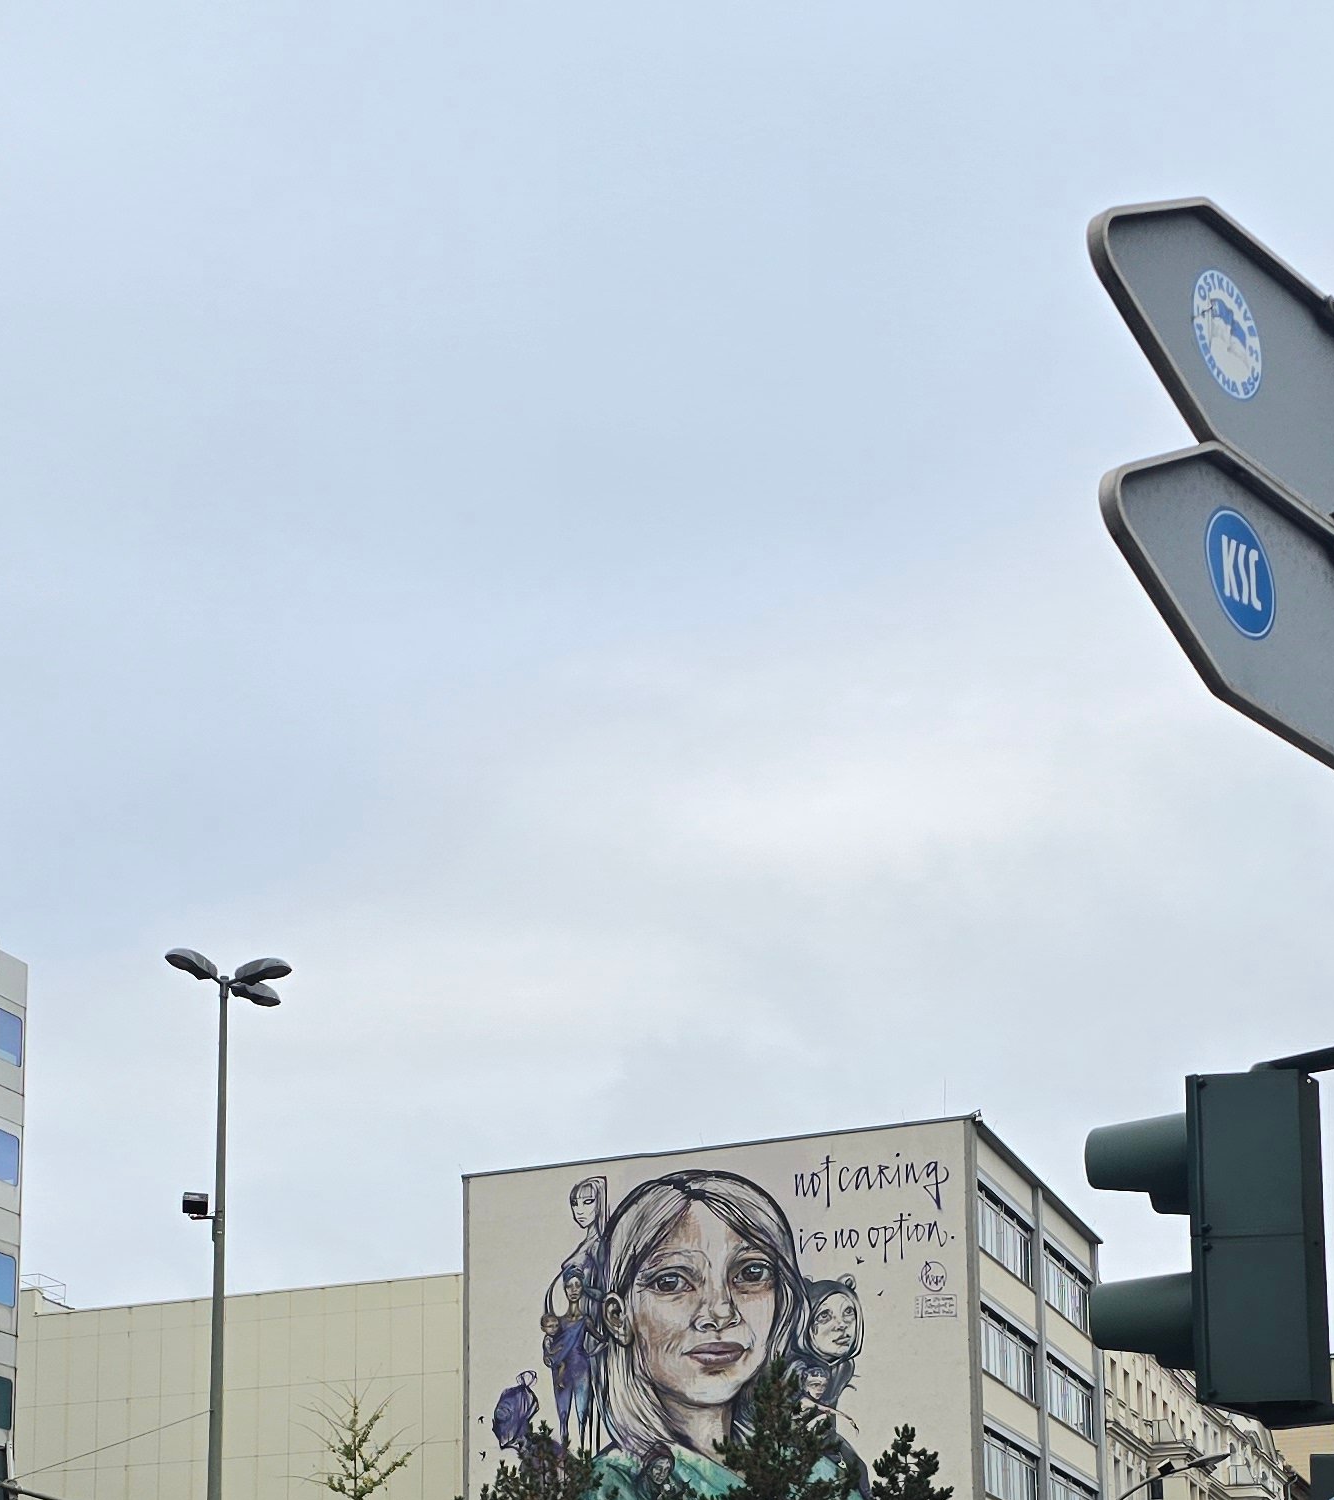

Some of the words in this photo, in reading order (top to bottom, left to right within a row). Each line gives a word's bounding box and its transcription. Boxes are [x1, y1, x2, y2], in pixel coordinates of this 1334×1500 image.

[1197, 272, 1258, 337] OSTKURVE
[1241, 366, 1259, 396] BSC
[1221, 534, 1262, 612] KSC
[794, 1155, 837, 1208] not
[799, 1228, 828, 1254] is
[834, 1228, 860, 1249] no
[867, 1212, 955, 1264] option.
